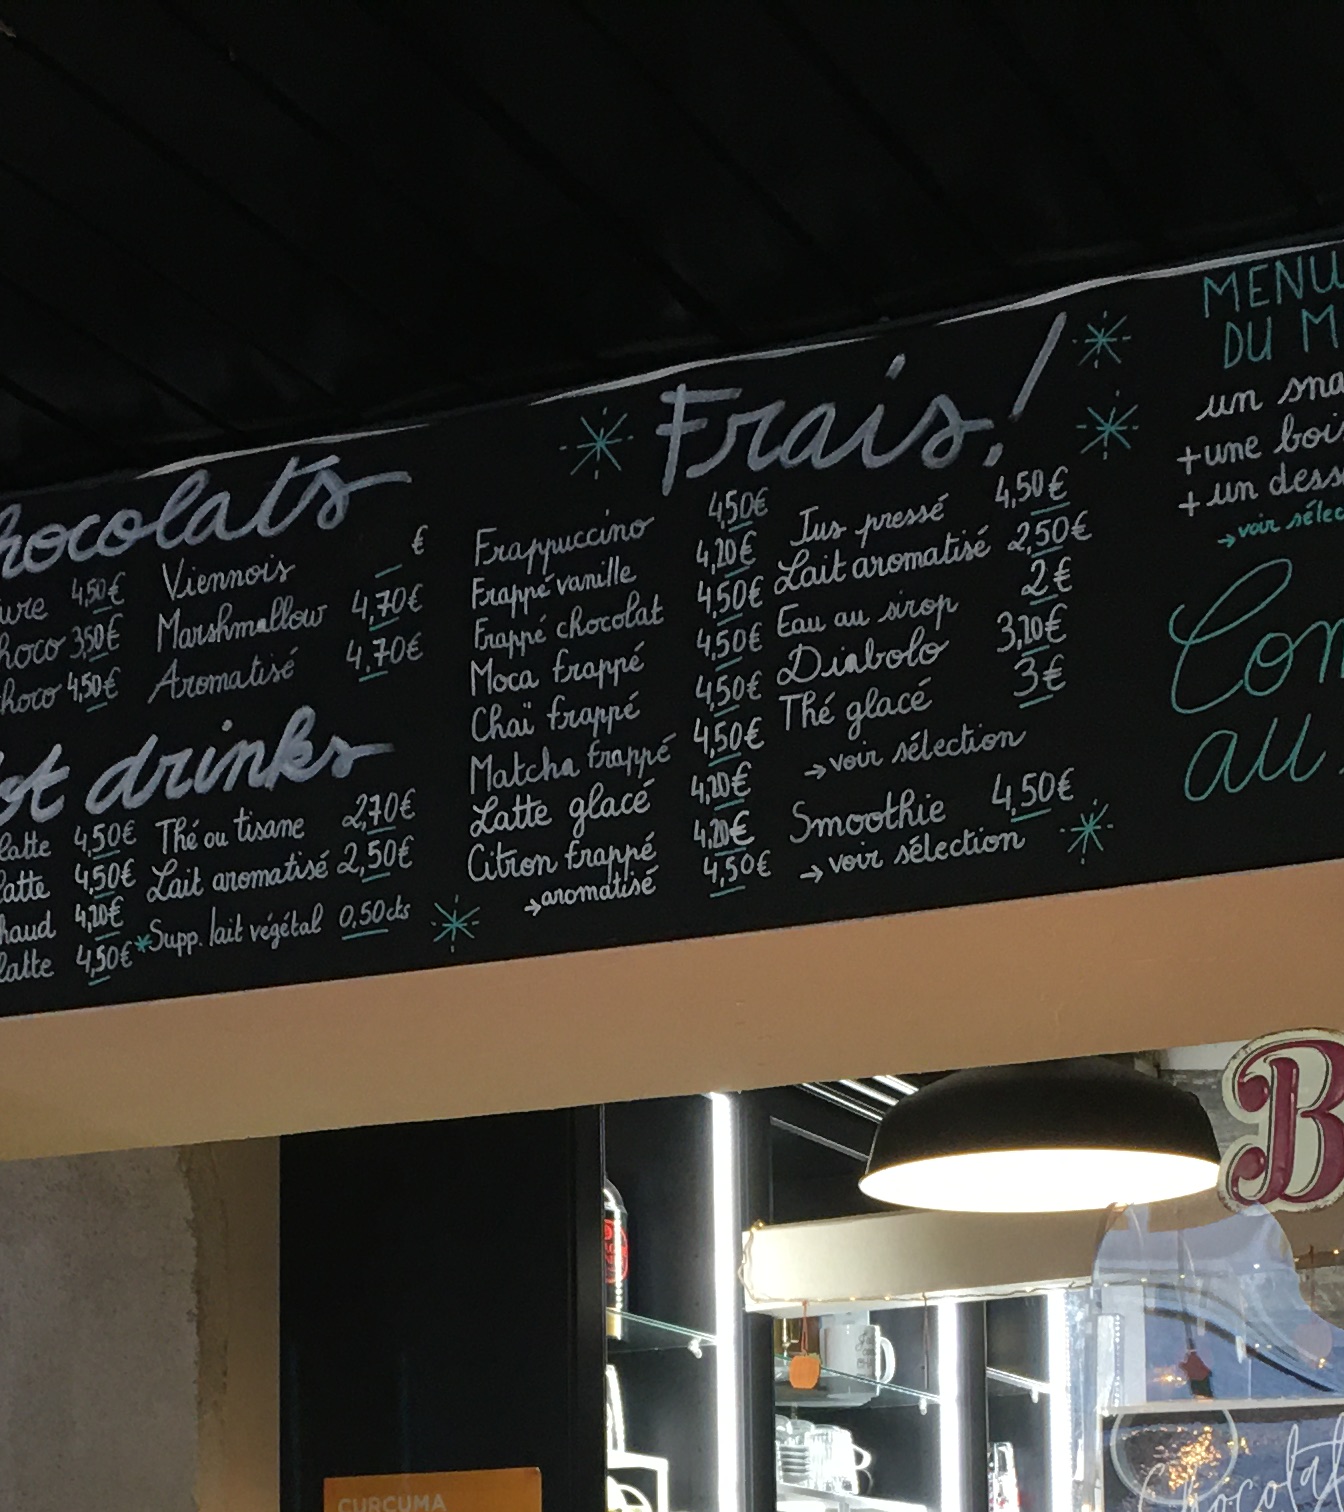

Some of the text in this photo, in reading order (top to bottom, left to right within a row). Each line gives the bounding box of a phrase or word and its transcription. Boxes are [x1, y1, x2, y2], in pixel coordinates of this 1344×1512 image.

[1223, 314, 1272, 369] DU
[1197, 385, 1263, 422] un
[474, 509, 655, 568] Frappuccino
[157, 596, 328, 653] Marshmallow
[148, 648, 299, 704] Aromatisé
[471, 640, 646, 696] Moca frappé
[777, 640, 950, 686] Diabolo
[782, 677, 933, 740] Thé glacé
[86, 705, 395, 815] drinks
[1185, 713, 1326, 801] au
[790, 790, 947, 845] Smoothie
